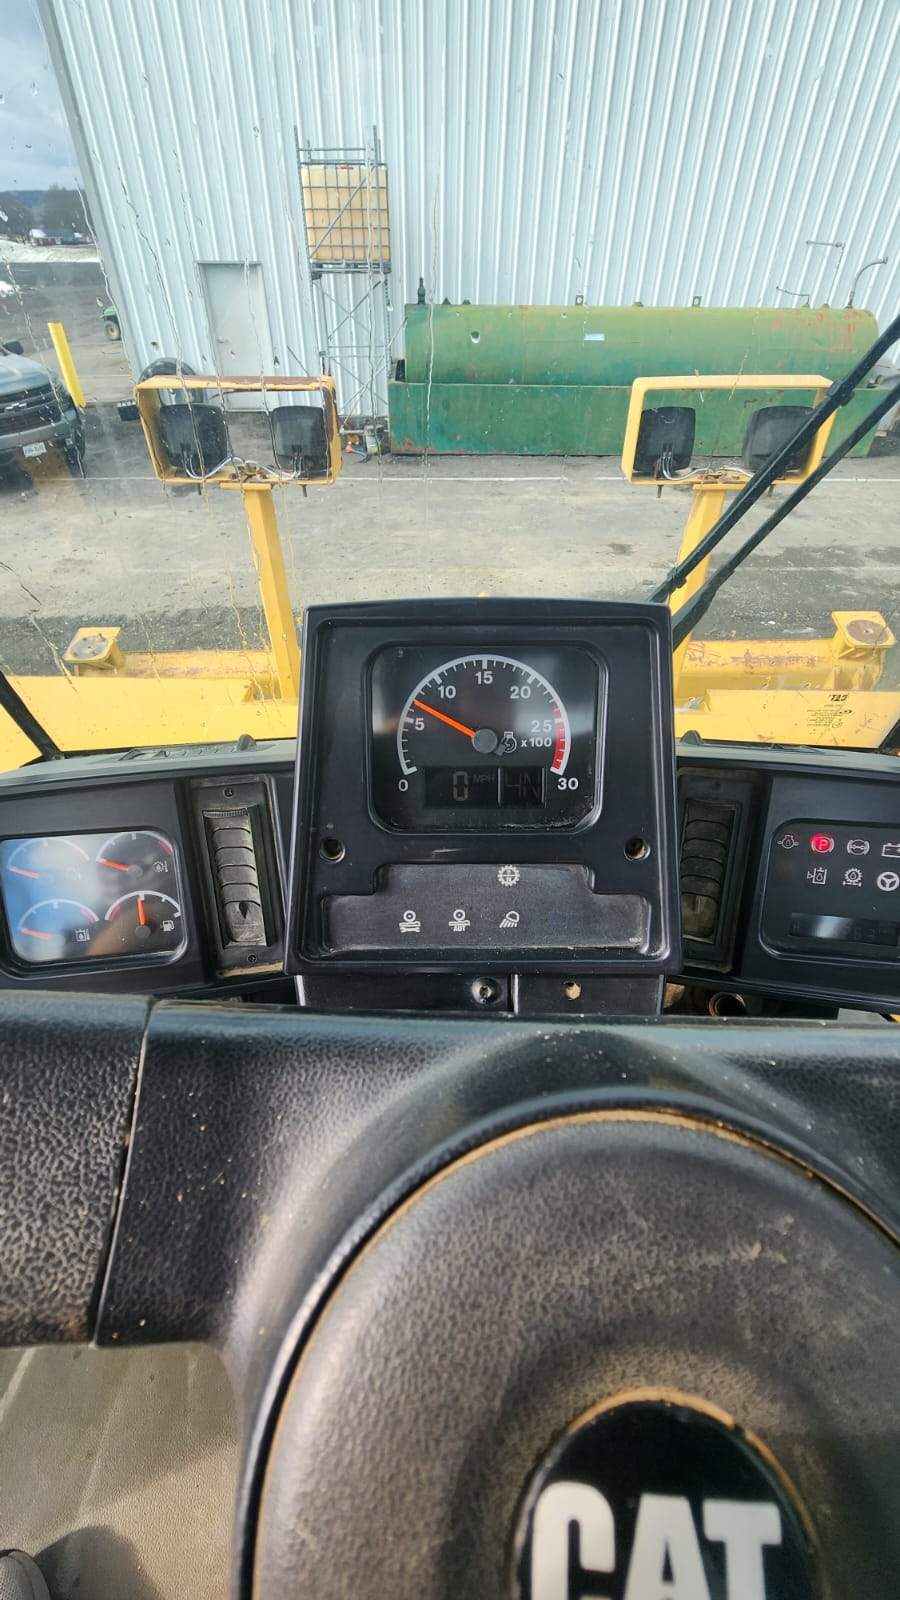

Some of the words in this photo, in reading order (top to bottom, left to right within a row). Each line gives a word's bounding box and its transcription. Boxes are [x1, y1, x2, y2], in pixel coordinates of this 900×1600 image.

[475, 671, 493, 684] 15
[438, 685, 456, 699] 10
[509, 685, 531, 699] 20
[414, 718, 425, 731] 5
[531, 720, 552, 733] 25
[398, 779, 409, 792] 0
[452, 771, 469, 801] 0
[557, 778, 579, 791] 30
[531, 1481, 782, 1600] CAT
